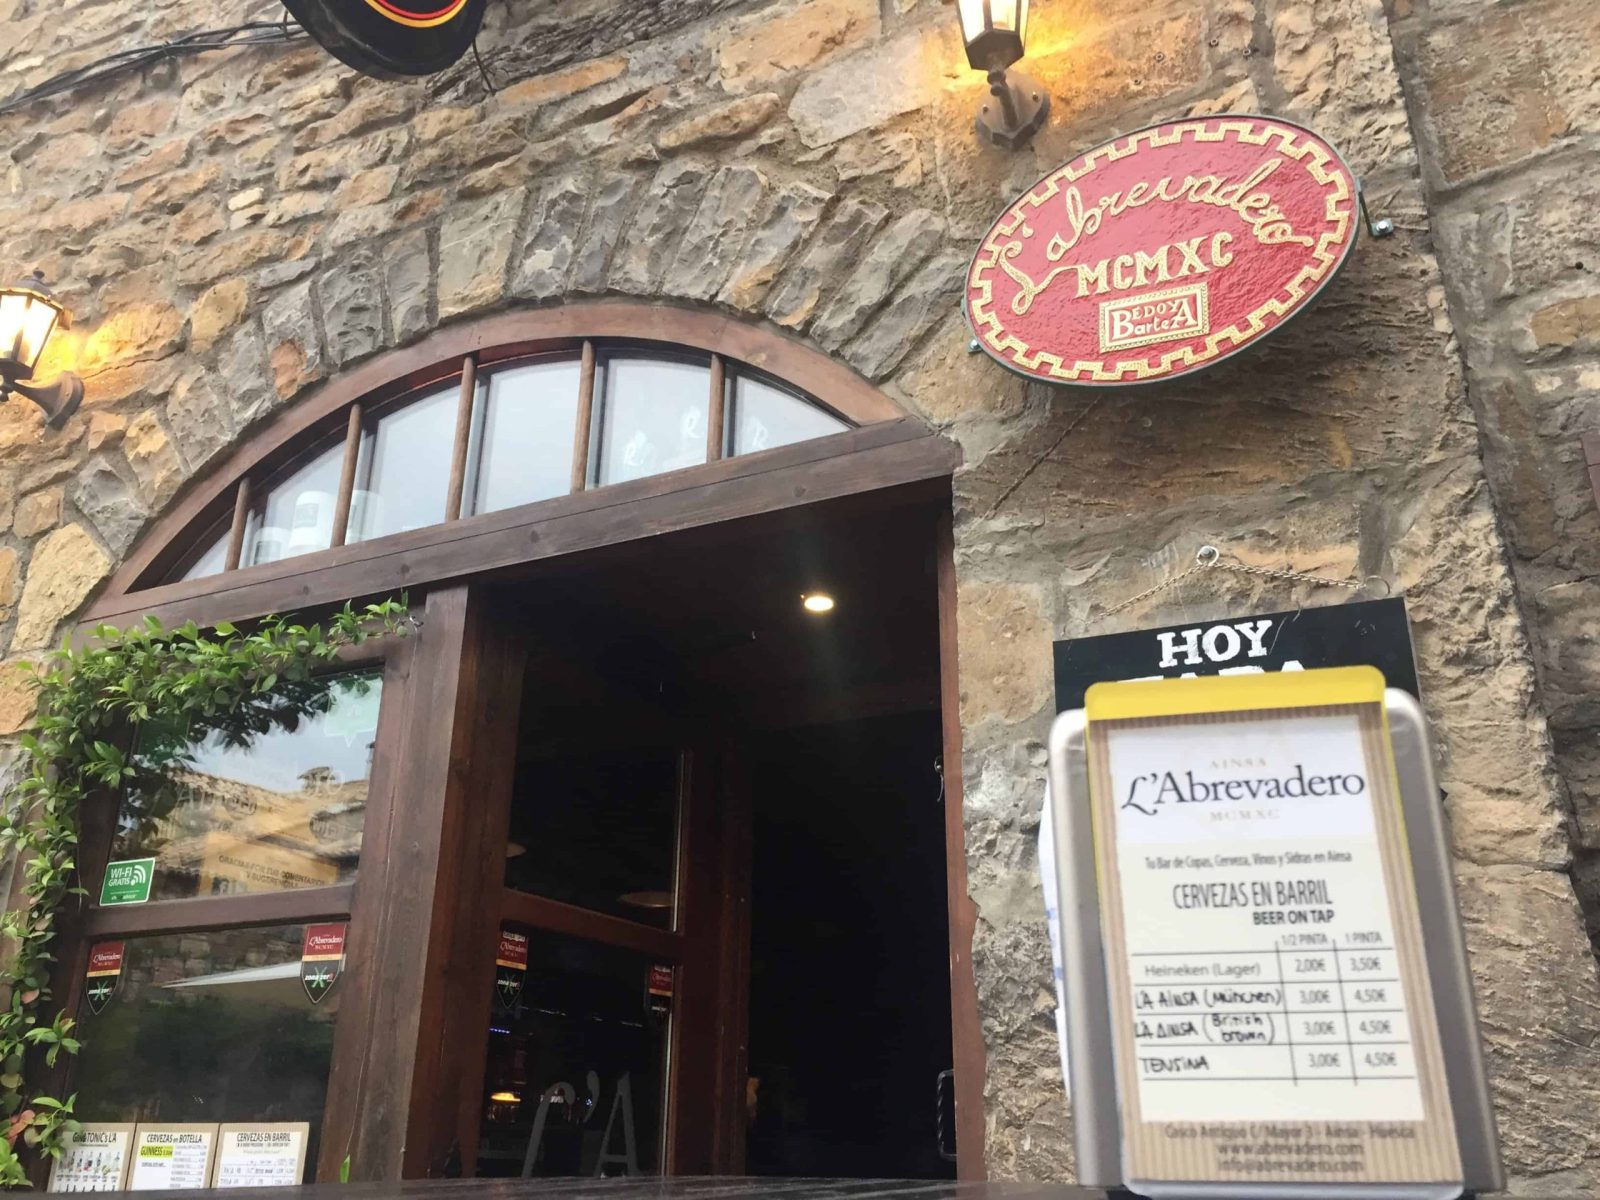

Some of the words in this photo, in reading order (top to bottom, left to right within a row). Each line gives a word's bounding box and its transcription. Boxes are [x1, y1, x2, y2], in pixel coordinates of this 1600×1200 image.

[1073, 232, 1233, 297] MCMXC
[1157, 619, 1272, 668] HOY
[1121, 764, 1365, 816] L'Abrevadero
[1209, 809, 1280, 822] MCMXC
[1157, 857, 1171, 869] Bar
[1173, 856, 1184, 868] de
[111, 866, 132, 878] WI-FI
[108, 878, 131, 887] GRATIS
[1172, 882, 1249, 909] CERVEZAS
[1251, 881, 1273, 906] EN
[1275, 879, 1333, 906] BARRIL
[1253, 911, 1286, 925] BEER
[1288, 910, 1309, 924] ON
[1311, 909, 1335, 923] TAP
[1281, 935, 1297, 946] 1/2
[1299, 934, 1328, 946] PINTA
[1352, 932, 1382, 944] PINTA
[1145, 963, 1209, 977] Heineken
[1213, 962, 1261, 978] (Lager)
[1295, 959, 1326, 973] 2,00€
[1350, 957, 1381, 971] 3,50€
[1299, 990, 1330, 1004] 3,00€
[1354, 988, 1387, 1003] 4,50€
[1304, 1021, 1336, 1036] 3,00€
[1359, 1020, 1392, 1034] 4,50€
[1308, 1053, 1341, 1068] 3,00€
[1364, 1052, 1397, 1067] 4,50€
[147, 1134, 173, 1143] CERVEZAS
[179, 1134, 203, 1144] BOTELLA
[237, 1133, 263, 1142] CERVEZAS
